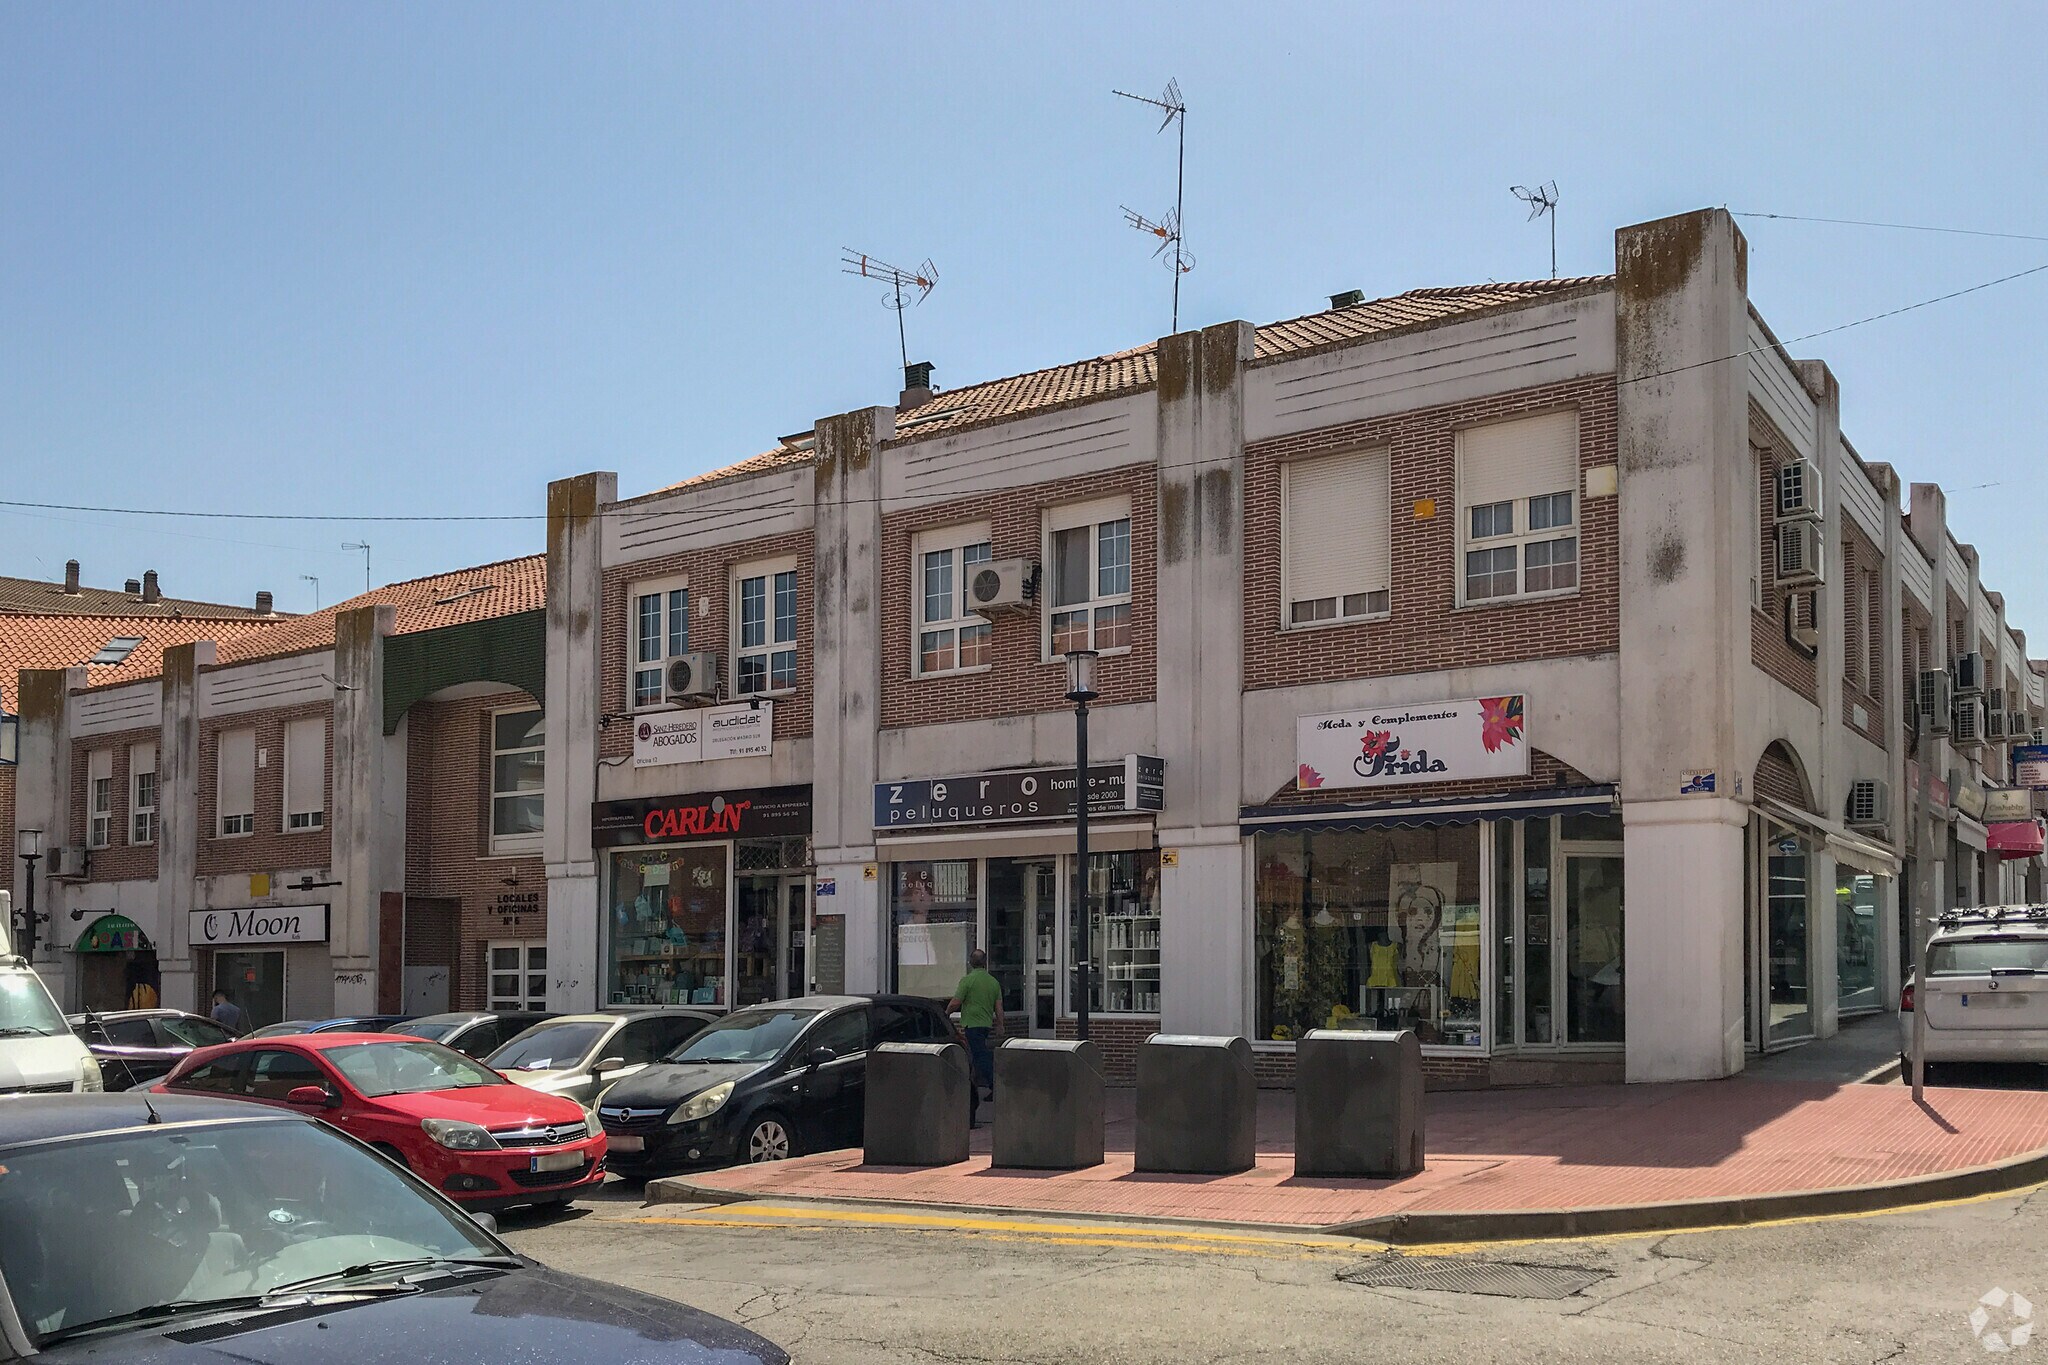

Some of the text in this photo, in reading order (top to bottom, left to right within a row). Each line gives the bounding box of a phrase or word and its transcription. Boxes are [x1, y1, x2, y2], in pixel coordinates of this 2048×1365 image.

[712, 715, 762, 728] audidat
[1317, 711, 1458, 730] Moda y Complementos
[652, 732, 697, 747] ABOGADOS
[1353, 736, 1448, 777] Frida
[889, 776, 1038, 804] zero
[1100, 790, 1118, 799] 2000
[890, 801, 1039, 823] peluqueros
[1097, 804, 1107, 812] de
[1107, 802, 1126, 812] imag
[497, 893, 539, 904] LOCALES
[487, 904, 539, 915] Y OFICINAS
[228, 910, 300, 938] Moon
